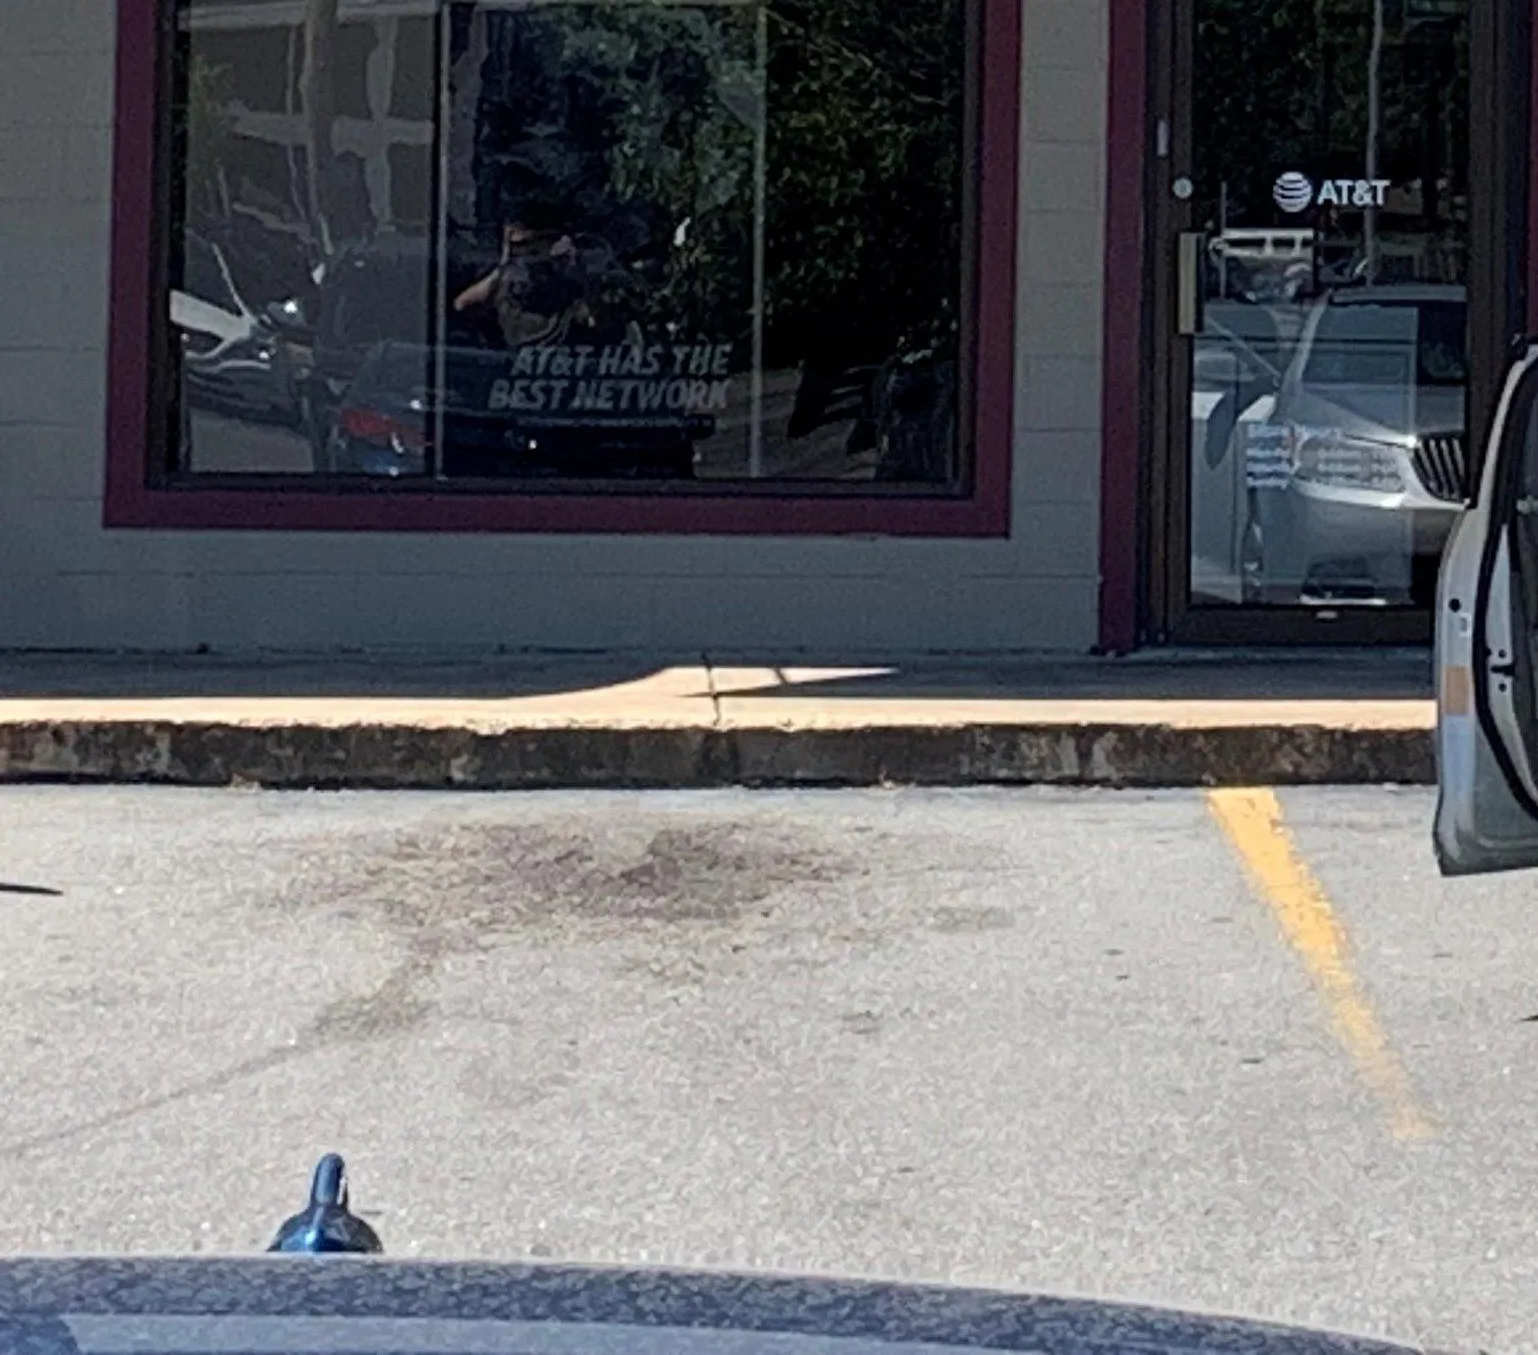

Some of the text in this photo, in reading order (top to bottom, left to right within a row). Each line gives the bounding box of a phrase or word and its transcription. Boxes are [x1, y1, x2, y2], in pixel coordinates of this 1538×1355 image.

[1316, 179, 1391, 206] AT&T
[510, 344, 733, 376] AT&T HAS THE
[487, 378, 733, 411] BEST NETWORK
